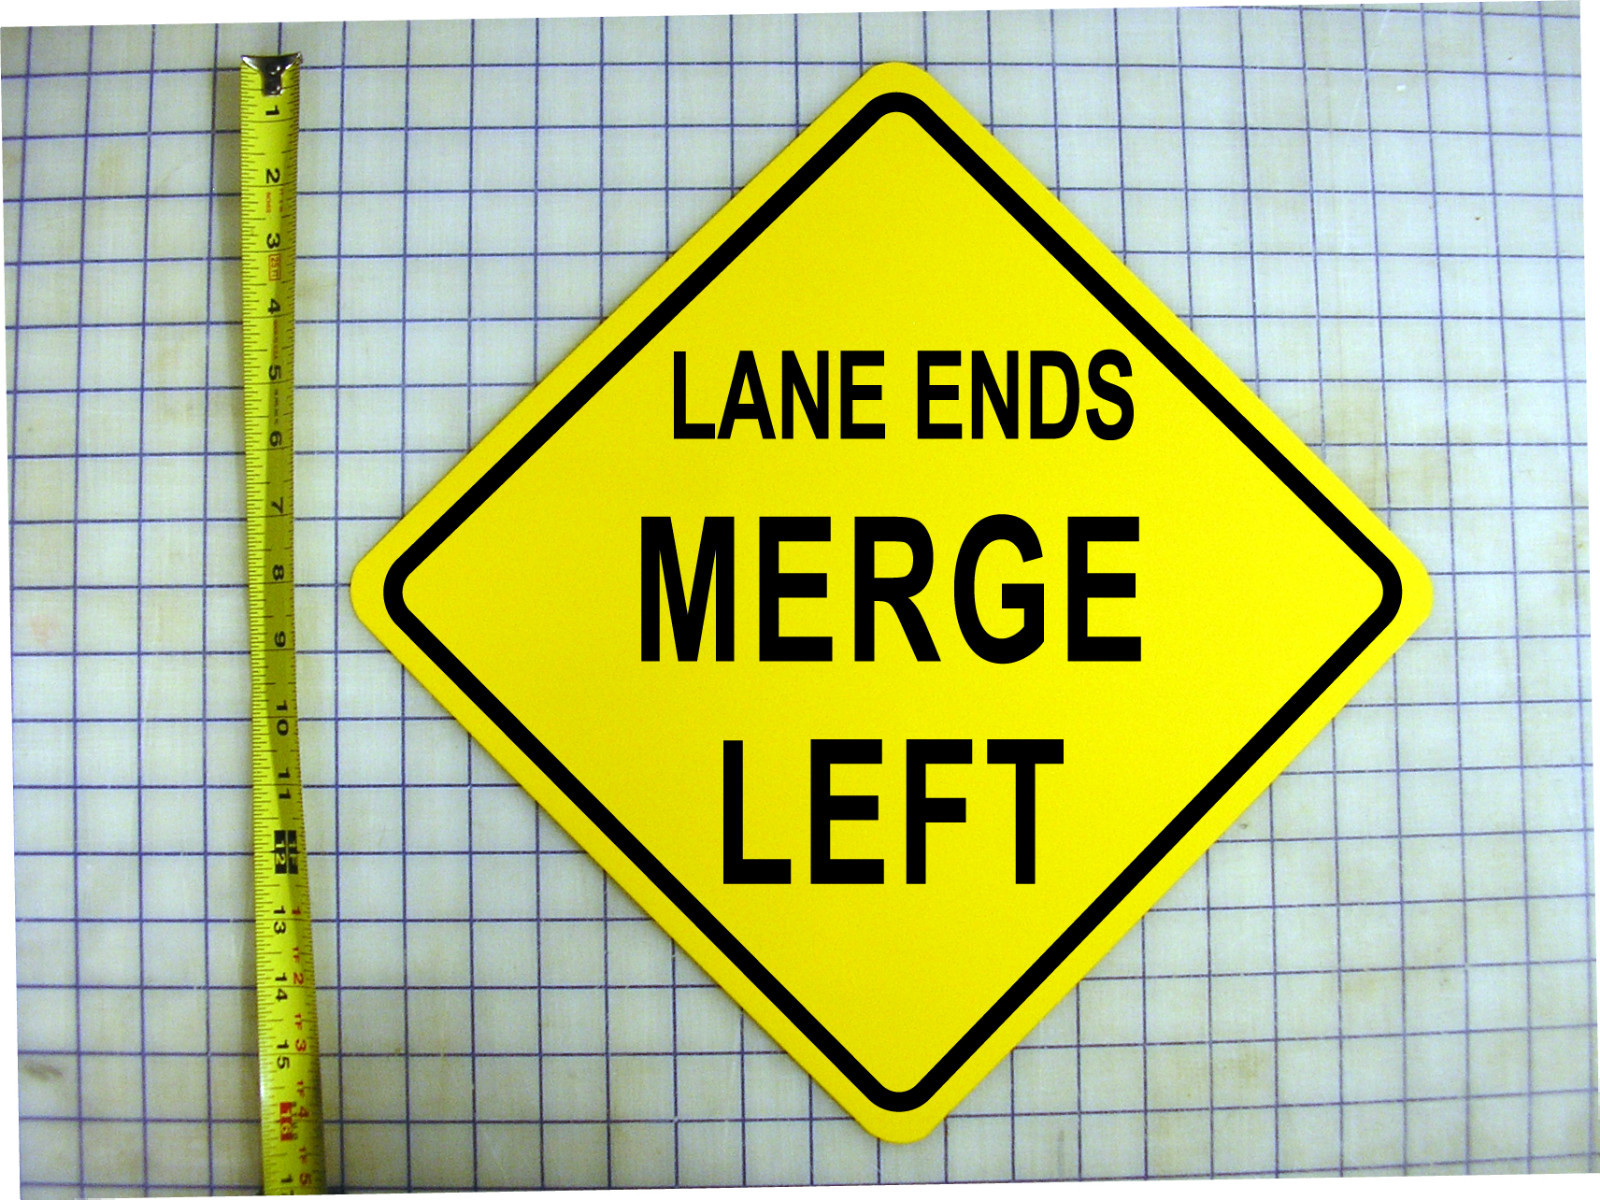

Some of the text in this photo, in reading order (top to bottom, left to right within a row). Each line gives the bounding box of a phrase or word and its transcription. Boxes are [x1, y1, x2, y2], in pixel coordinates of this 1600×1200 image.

[265, 104, 281, 116] 1
[265, 167, 281, 184] 2
[266, 232, 281, 249] 3
[268, 298, 281, 314] 4
[268, 364, 282, 381] 5
[674, 350, 1135, 440] LANE ENDS
[269, 430, 283, 447] 6
[271, 496, 284, 514] 7
[272, 564, 285, 581] 8
[641, 514, 1142, 664] MERGE
[274, 631, 287, 648] 9
[276, 700, 289, 737] 10
[278, 767, 291, 799] 11
[723, 739, 1064, 884] LEFT
[275, 840, 286, 866] 12
[291, 905, 302, 916] 1
[273, 905, 287, 934] 13
[275, 972, 288, 1002] 14
[293, 972, 305, 985] 2
[295, 1038, 307, 1052] 3
[277, 1039, 290, 1070] 15
[298, 1105, 310, 1119] 4
[299, 1172, 313, 1187] 5
